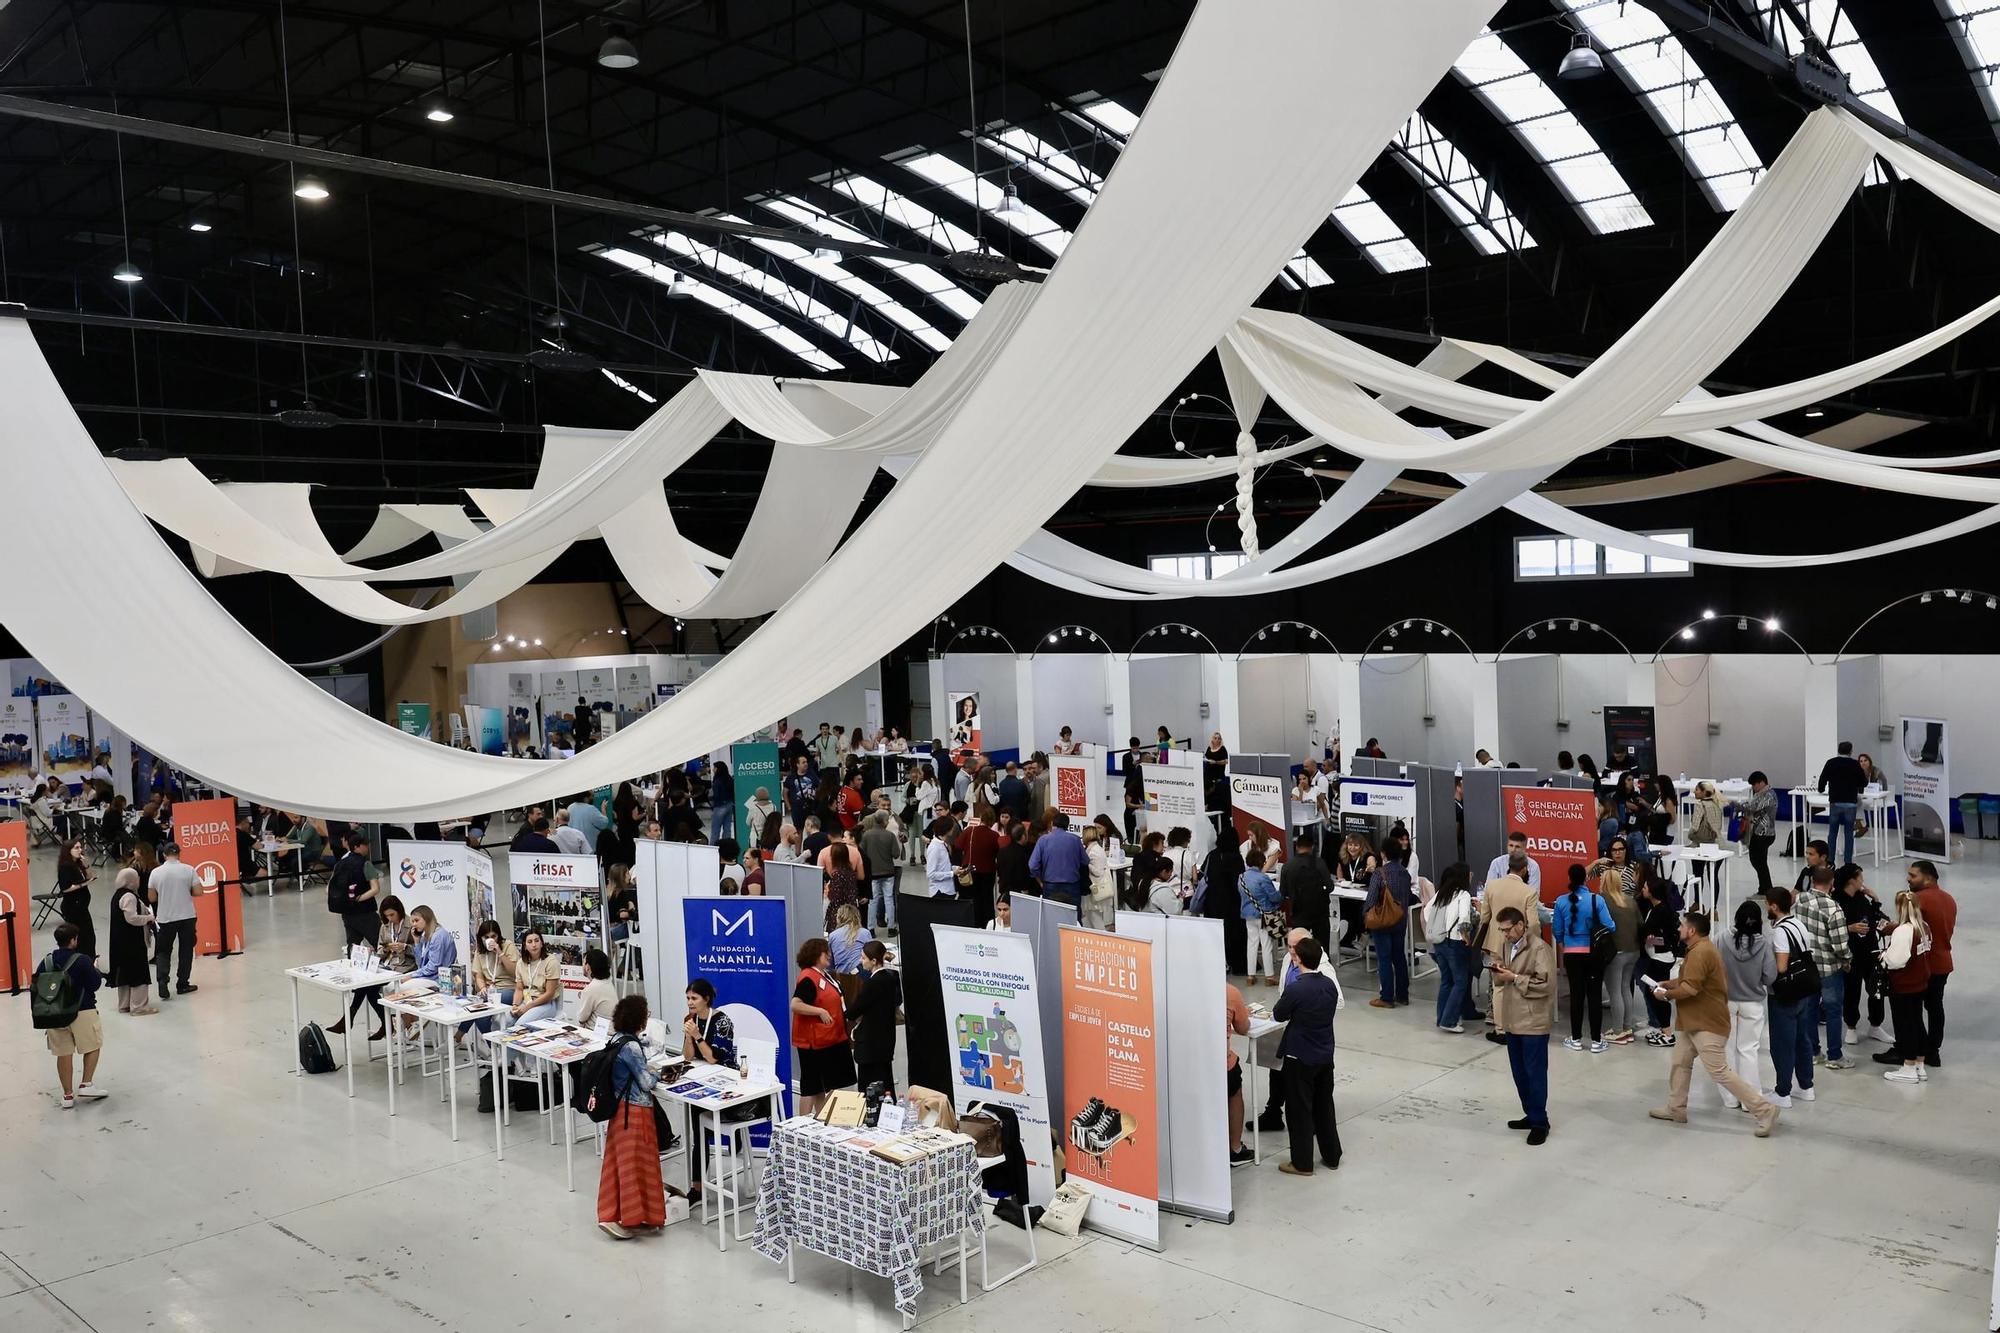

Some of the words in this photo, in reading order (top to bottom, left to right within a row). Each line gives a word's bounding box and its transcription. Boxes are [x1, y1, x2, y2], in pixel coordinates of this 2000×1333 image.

[738, 761, 775, 771] ACCESO
[1233, 778, 1279, 794] Cámara
[1528, 801, 1584, 811] GENERALITAT
[1529, 809, 1584, 820] VALENCIANA
[181, 820, 230, 837] EIXIDA
[182, 832, 230, 848] SALIDA
[1526, 837, 1587, 854] ABORA
[429, 869, 456, 884] Down
[541, 864, 573, 877] FISAT
[711, 945, 756, 953] FUNDACIÓN
[698, 954, 773, 965] MANANTIAL
[1127, 956, 1136, 970] IN
[946, 966, 982, 977] ITINERARIOS
[991, 972, 1024, 982] INSERCIÓN
[1075, 960, 1137, 991] EMPLEO
[942, 973, 984, 985] SOCIOLABORAL
[985, 979, 1000, 987] CON
[1001, 981, 1030, 991] ENFOQUE
[1107, 1021, 1151, 1038] CASTELLÓ
[1108, 1034, 1120, 1046] DE
[1122, 1037, 1134, 1048] LA
[1108, 1048, 1140, 1063] PLANA
